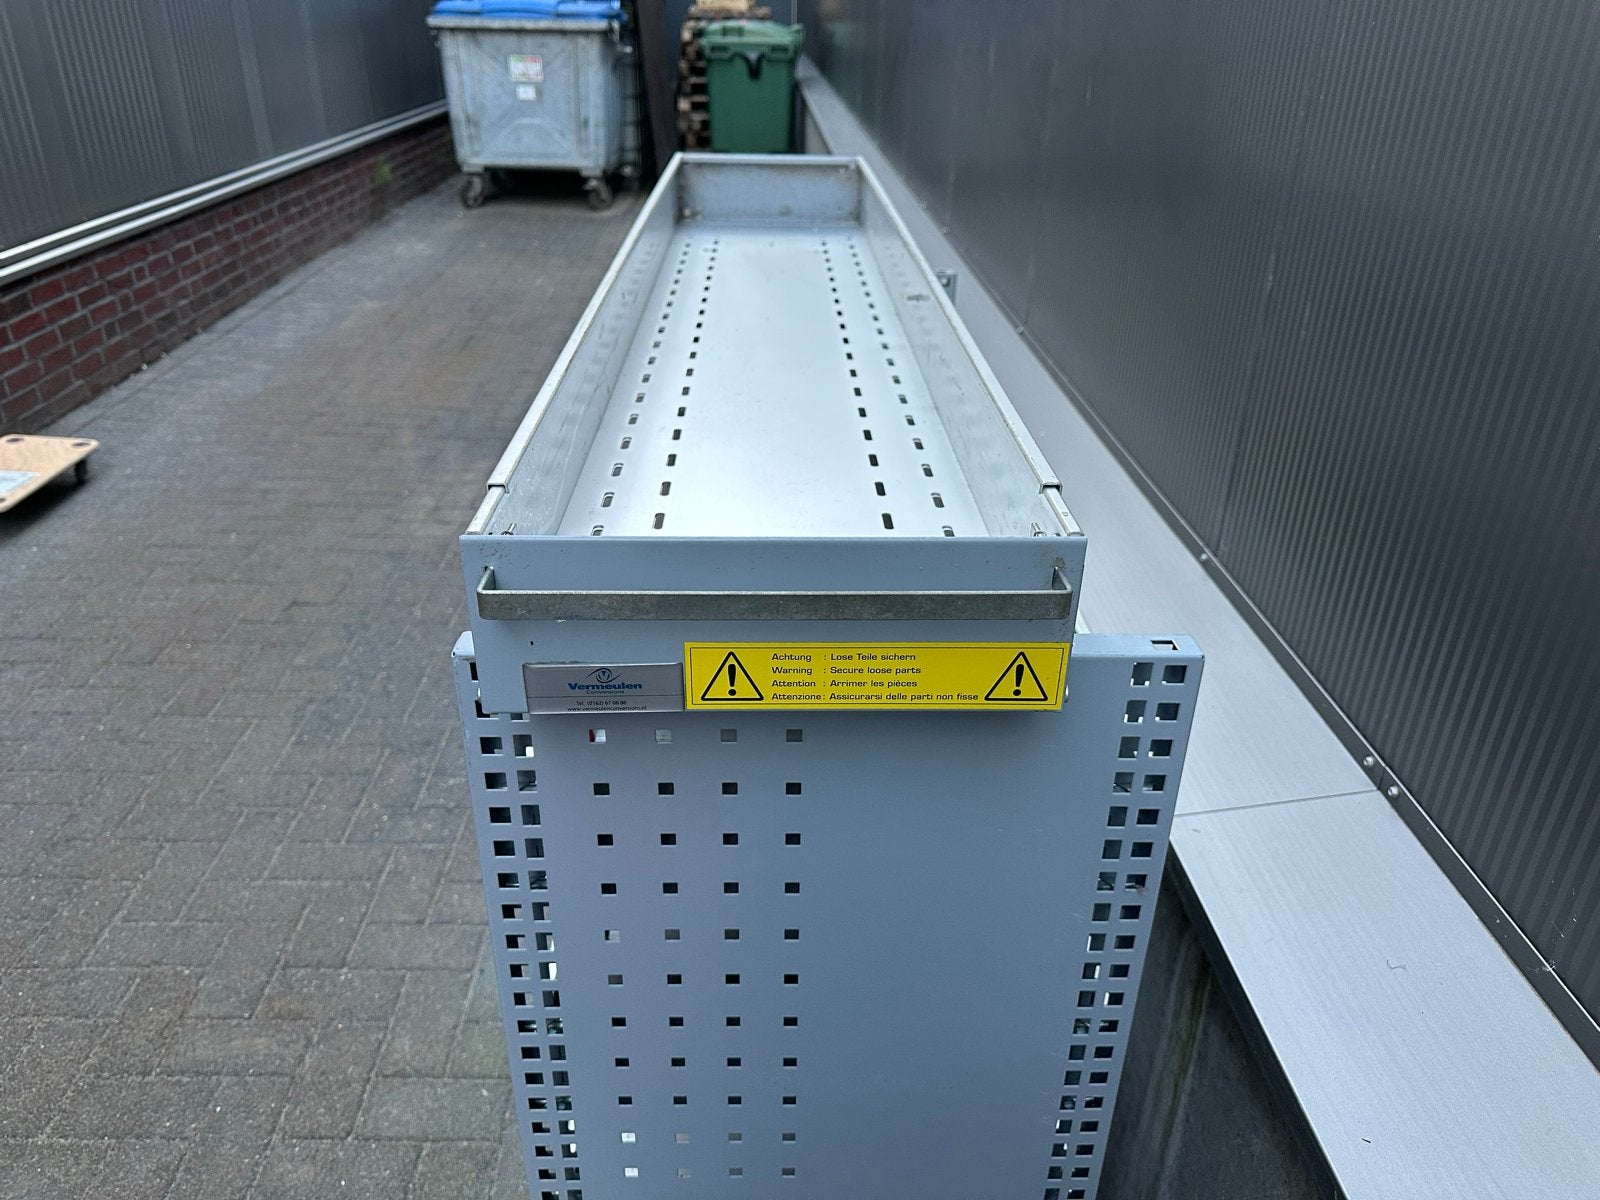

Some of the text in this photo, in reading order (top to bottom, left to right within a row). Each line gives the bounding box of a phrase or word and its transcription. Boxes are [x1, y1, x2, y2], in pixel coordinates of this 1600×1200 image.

[772, 653, 812, 662] Achtung
[830, 653, 853, 661] Lose
[857, 653, 877, 661] Teile
[881, 653, 916, 661] sichern
[772, 667, 812, 675] Warning
[887, 680, 918, 688] pièces
[829, 693, 883, 701] Assicurarsi
[910, 693, 933, 701] parti
